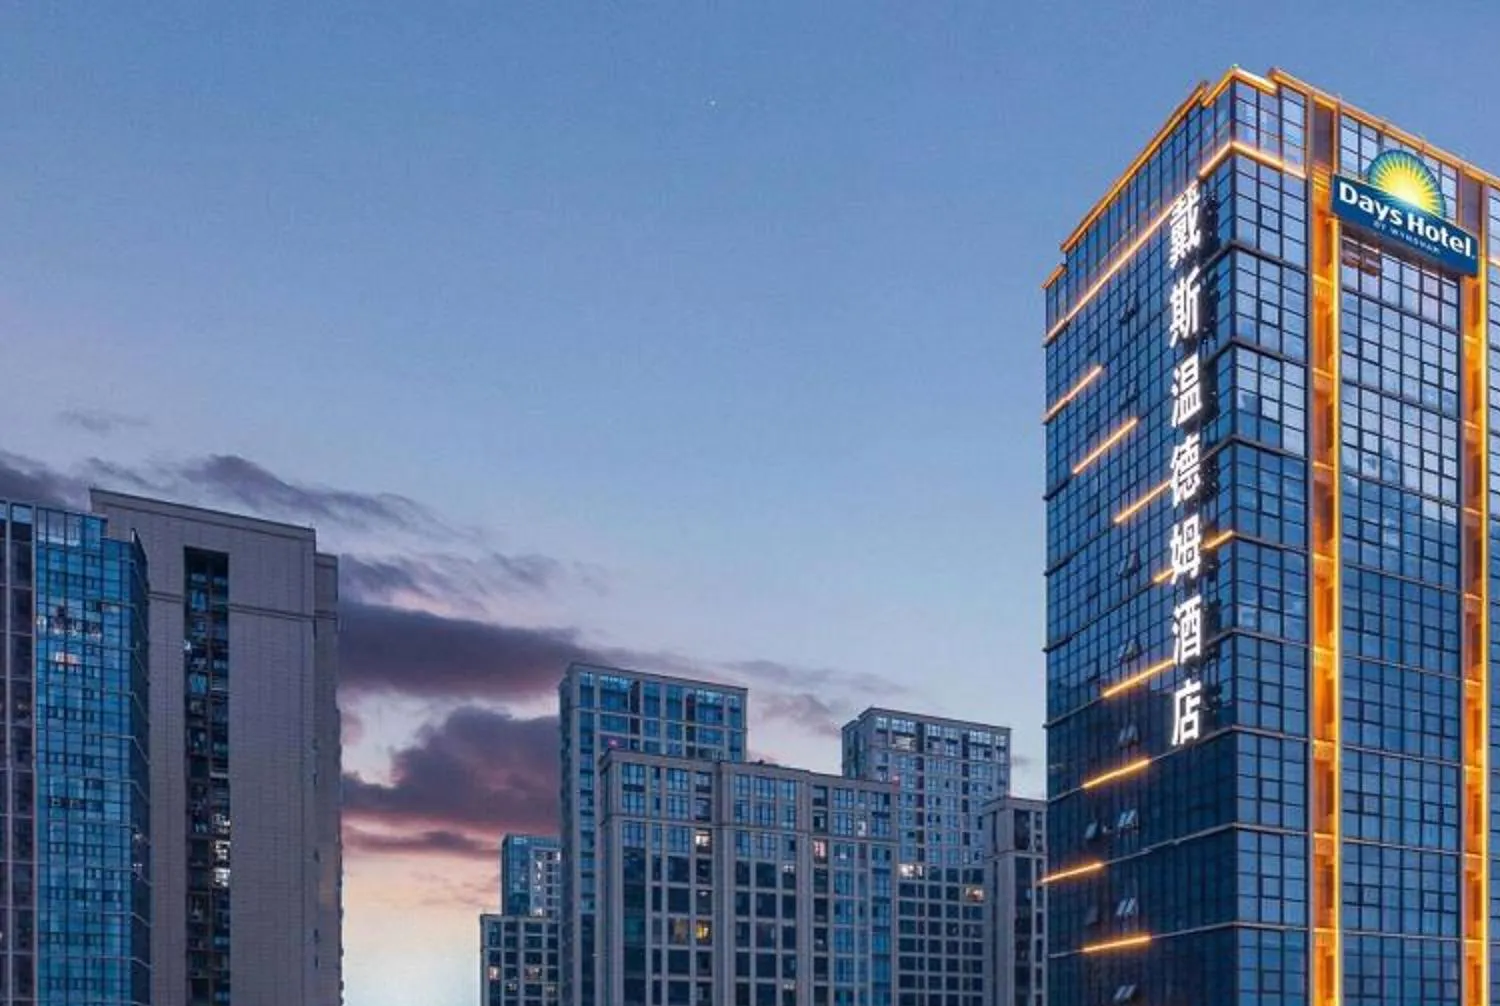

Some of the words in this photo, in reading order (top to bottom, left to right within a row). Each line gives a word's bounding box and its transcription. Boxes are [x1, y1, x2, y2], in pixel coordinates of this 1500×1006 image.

[1339, 181, 1403, 227] Days
[1407, 212, 1471, 257] Hotel
[1169, 184, 1202, 746] 戴斯温德姆酒店
